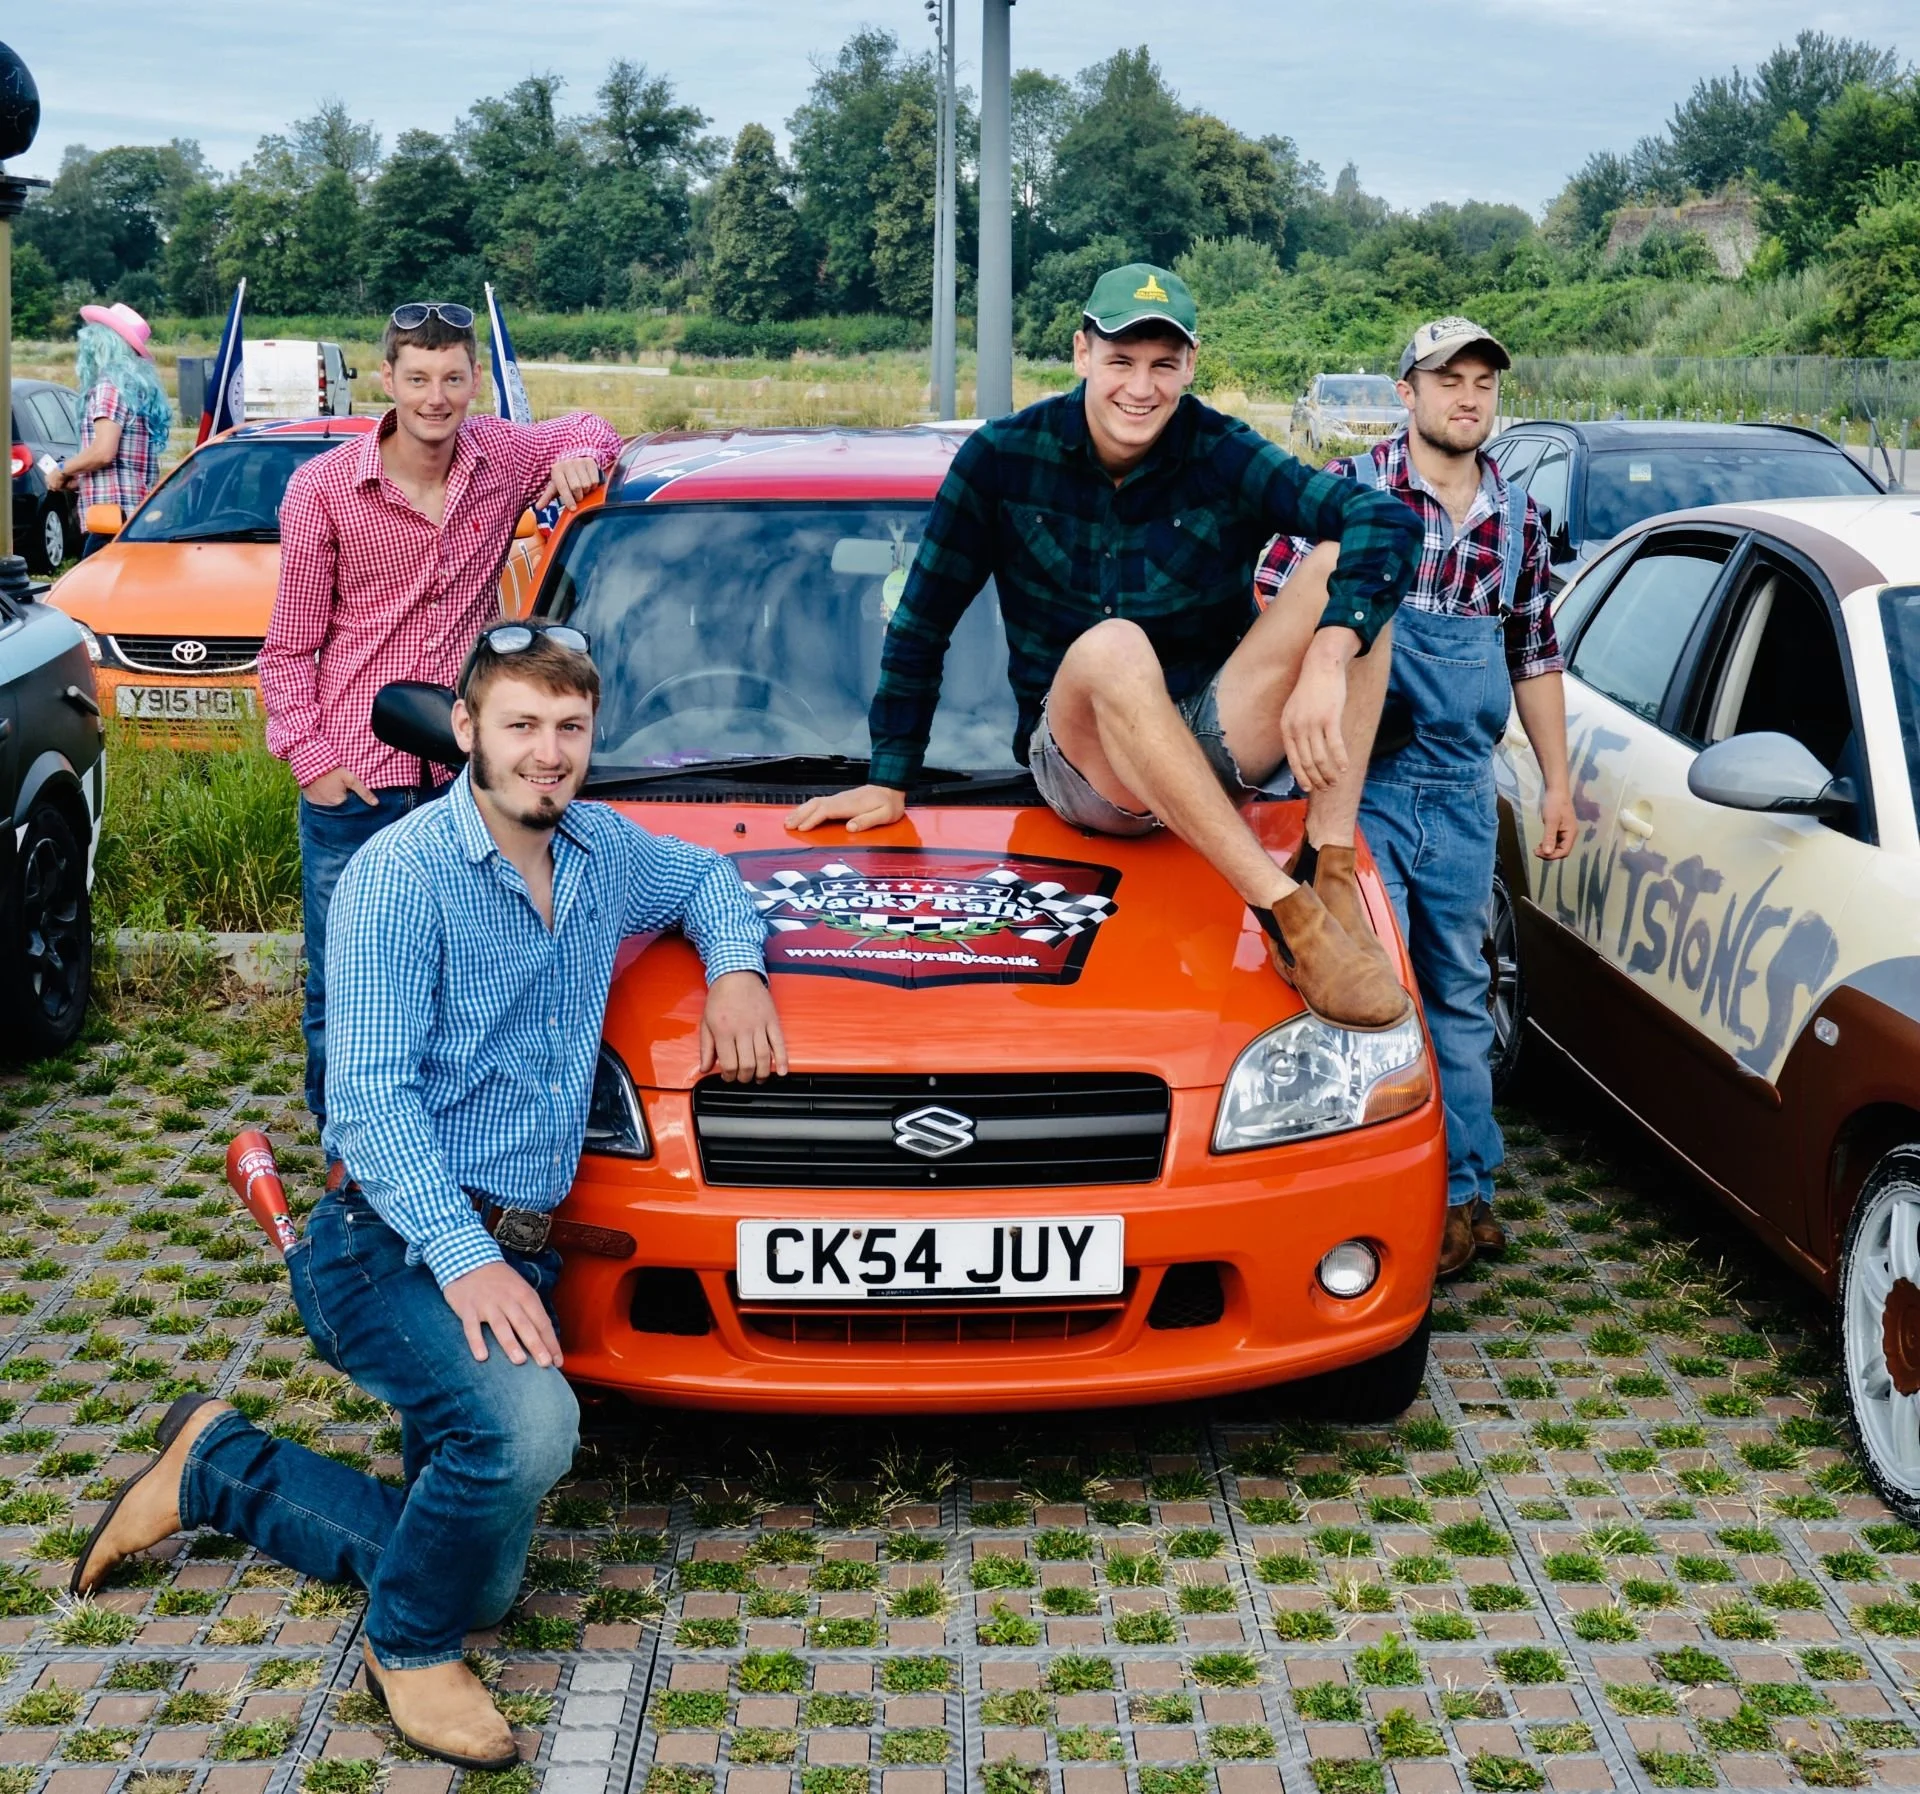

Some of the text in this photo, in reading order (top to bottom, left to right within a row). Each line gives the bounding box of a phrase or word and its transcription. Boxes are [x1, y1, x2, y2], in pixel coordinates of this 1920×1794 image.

[130, 688, 188, 713] Y915
[785, 889, 1044, 922] Wacky Rally
[785, 948, 1039, 968] www.wackyrally.co.uk
[766, 1225, 1095, 1284] CK54 JUY
